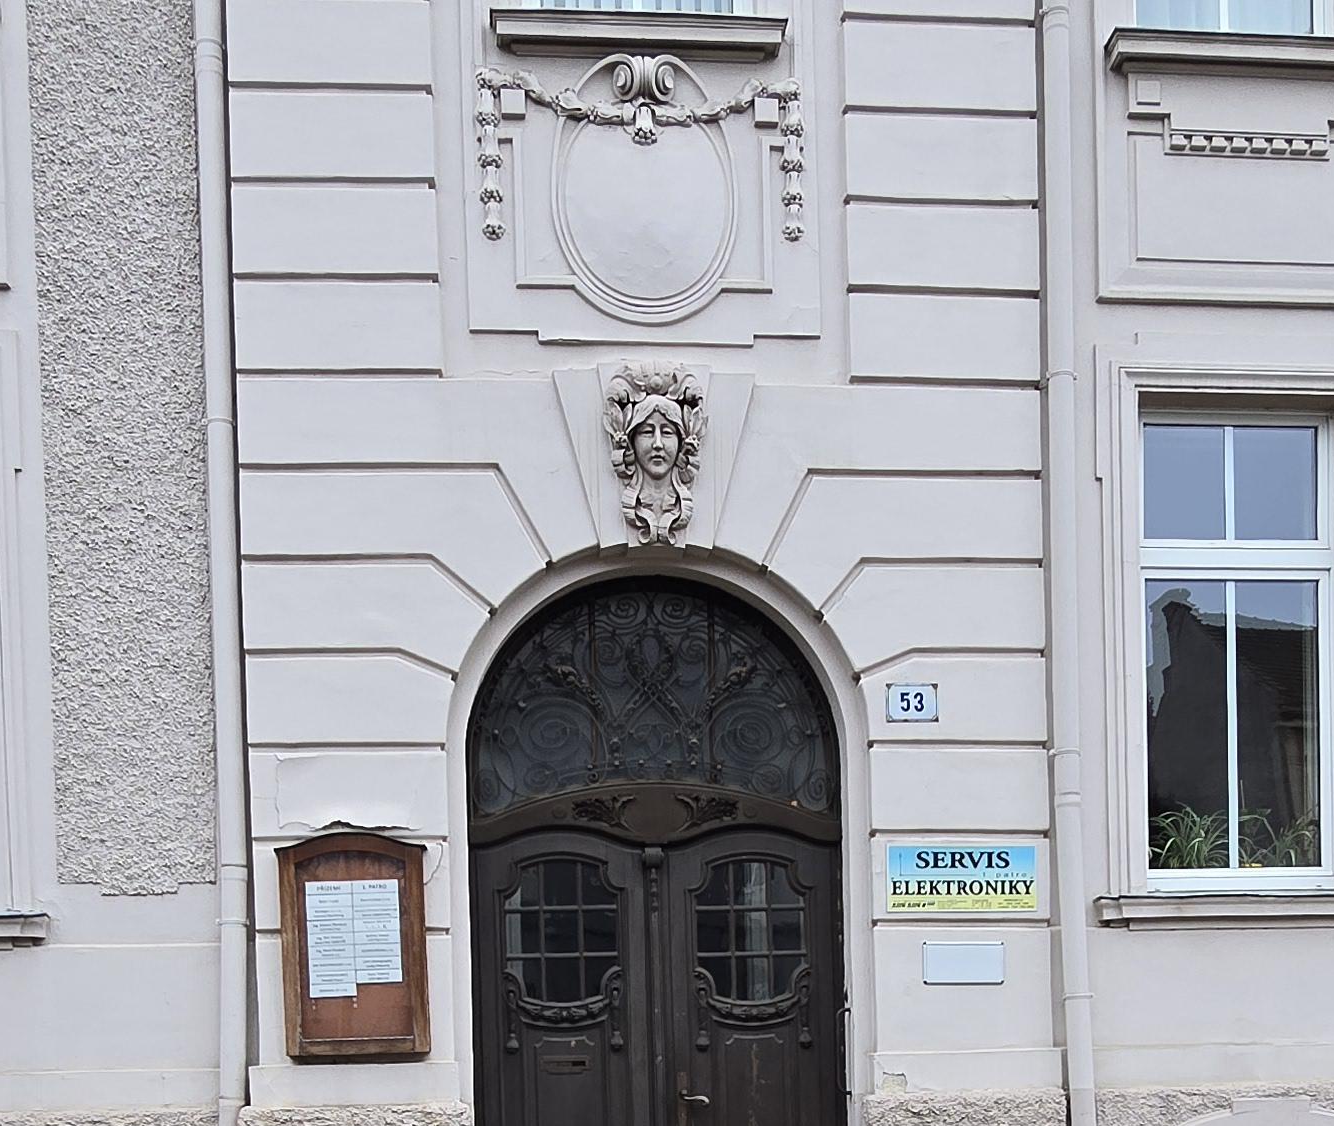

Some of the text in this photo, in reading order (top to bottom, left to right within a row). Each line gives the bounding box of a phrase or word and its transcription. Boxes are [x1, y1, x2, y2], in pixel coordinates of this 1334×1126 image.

[900, 692, 925, 712] 53
[915, 850, 1010, 869] SERVIS
[891, 880, 1034, 896] ELEKTRONIKY
